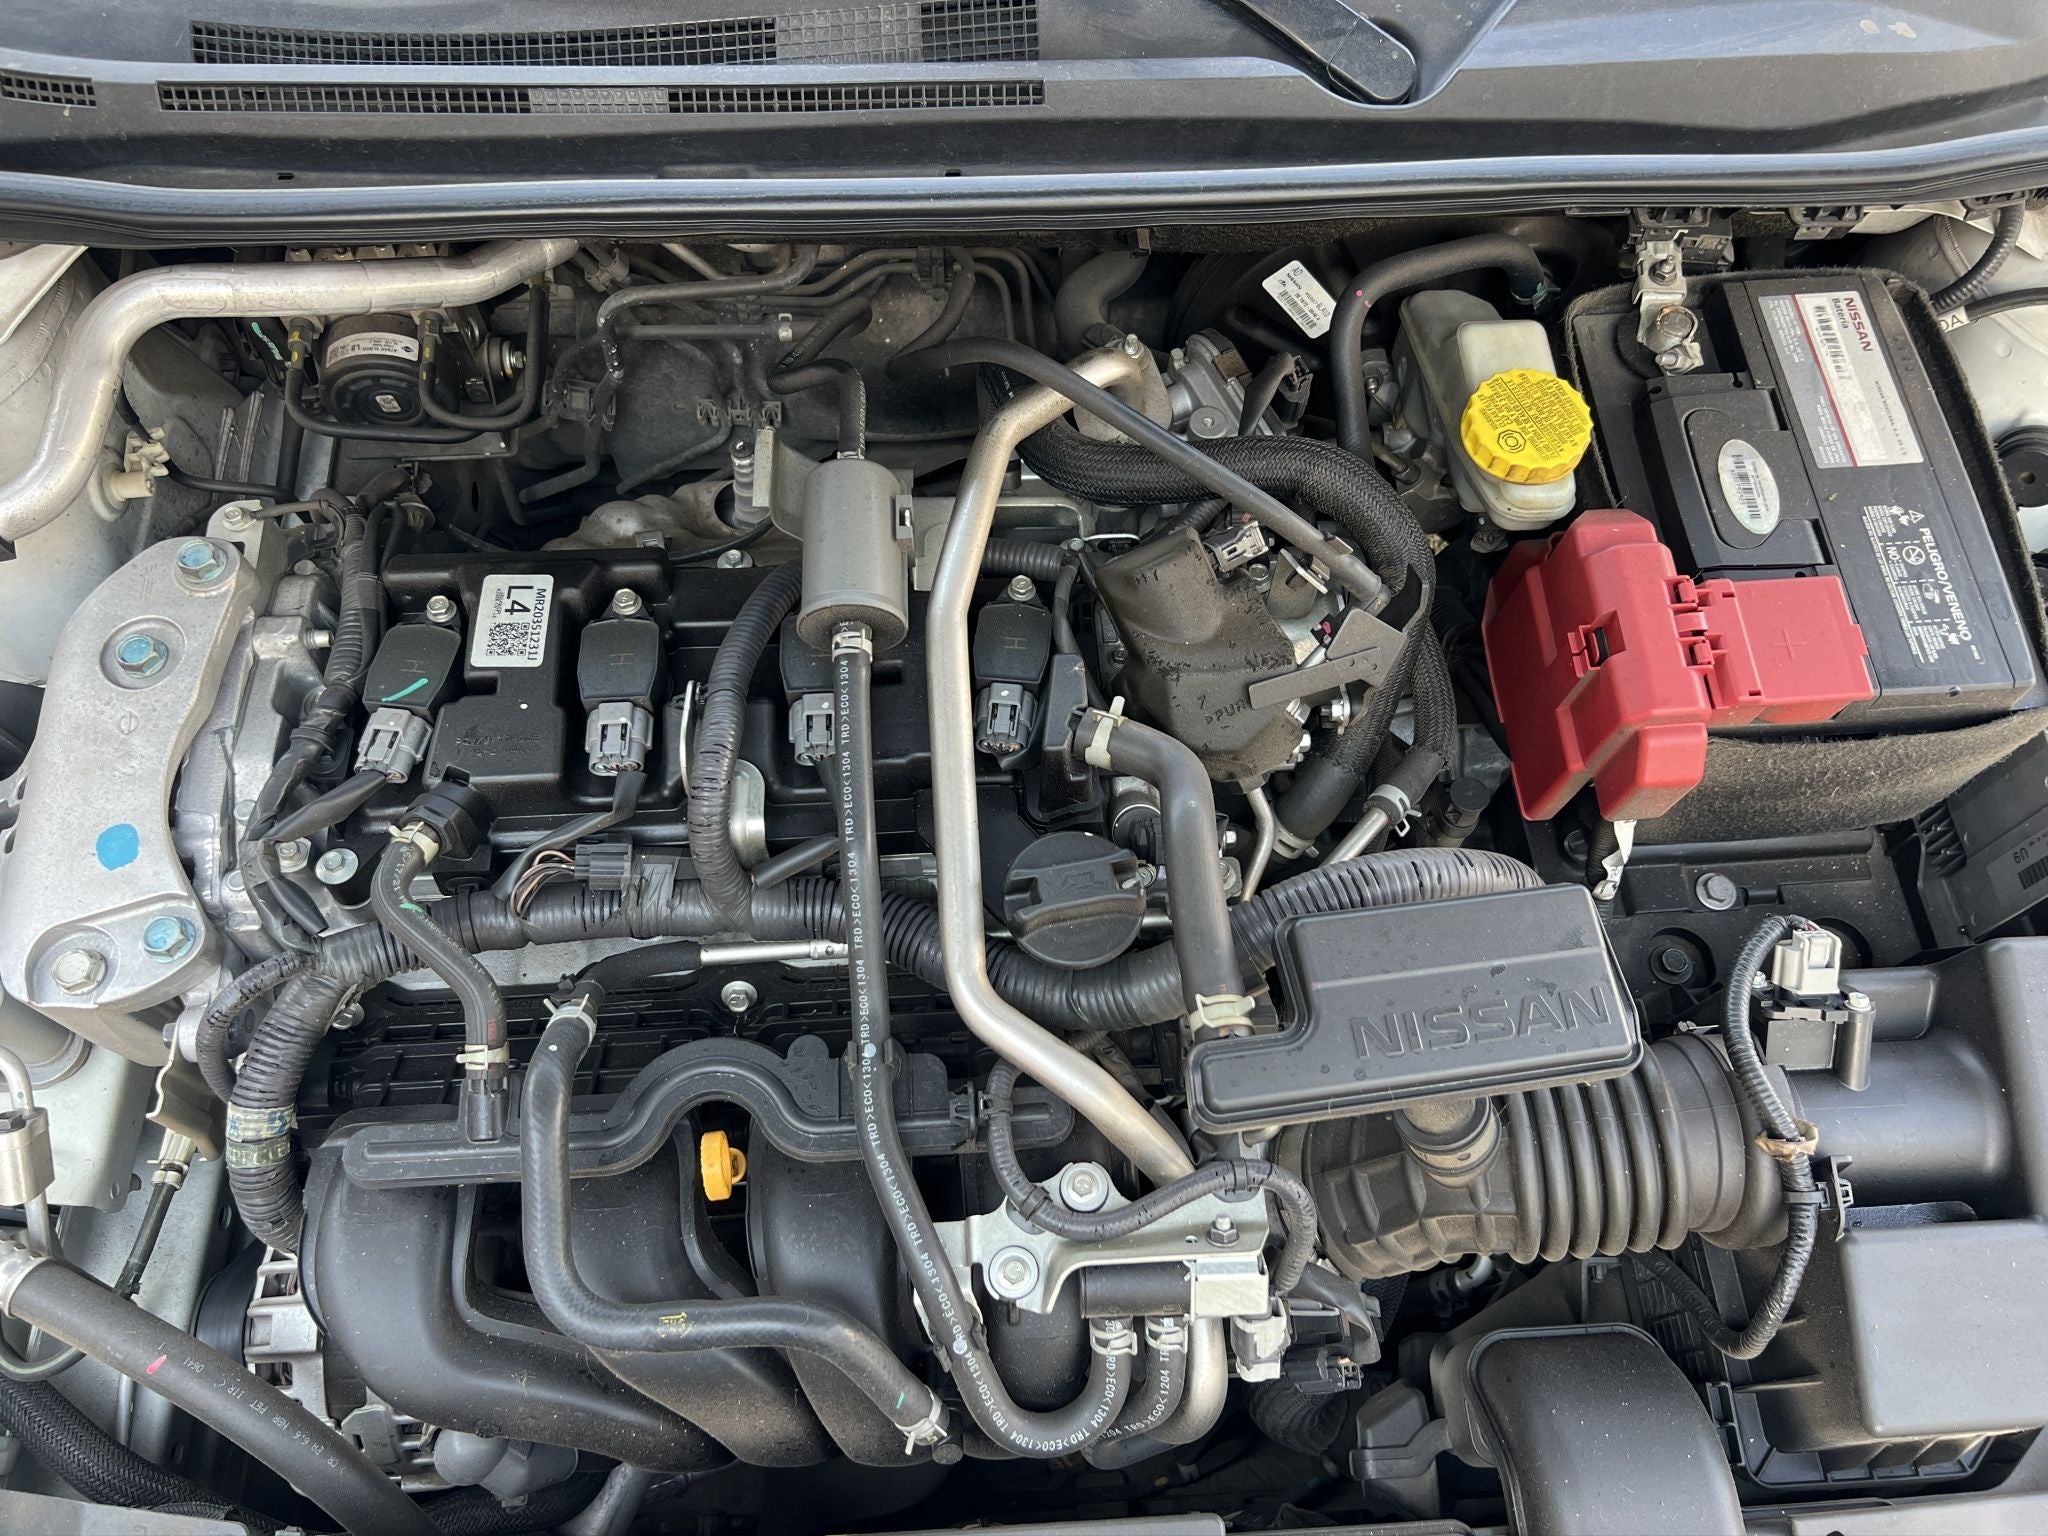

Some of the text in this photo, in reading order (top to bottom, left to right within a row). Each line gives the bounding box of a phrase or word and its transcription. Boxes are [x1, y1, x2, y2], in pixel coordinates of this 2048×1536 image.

[1831, 298, 1850, 328] Batería
[1843, 298, 1873, 351] NISSAN
[504, 586, 534, 615] L4
[527, 588, 547, 661] MR20351231J
[1918, 528, 1972, 640] PELIGRO/VENENO
[840, 660, 850, 745] TRD>ECO<1304
[841, 751, 855, 842] TRD>ECO<1304
[848, 852, 863, 950] TRD>ECO<1304
[856, 959, 870, 1045] TRD>ECO<1304
[1350, 986, 1612, 1058] NISSAN
[876, 1152, 924, 1248] TRD>ECO<1304
[920, 1252, 966, 1343] RD>ECO<1304
[962, 1351, 1010, 1435] TRD>ECO<1304
[1090, 1354, 1116, 1428] RD>ECO<1304
[1009, 1426, 1092, 1451] TRD>ECO<1304
